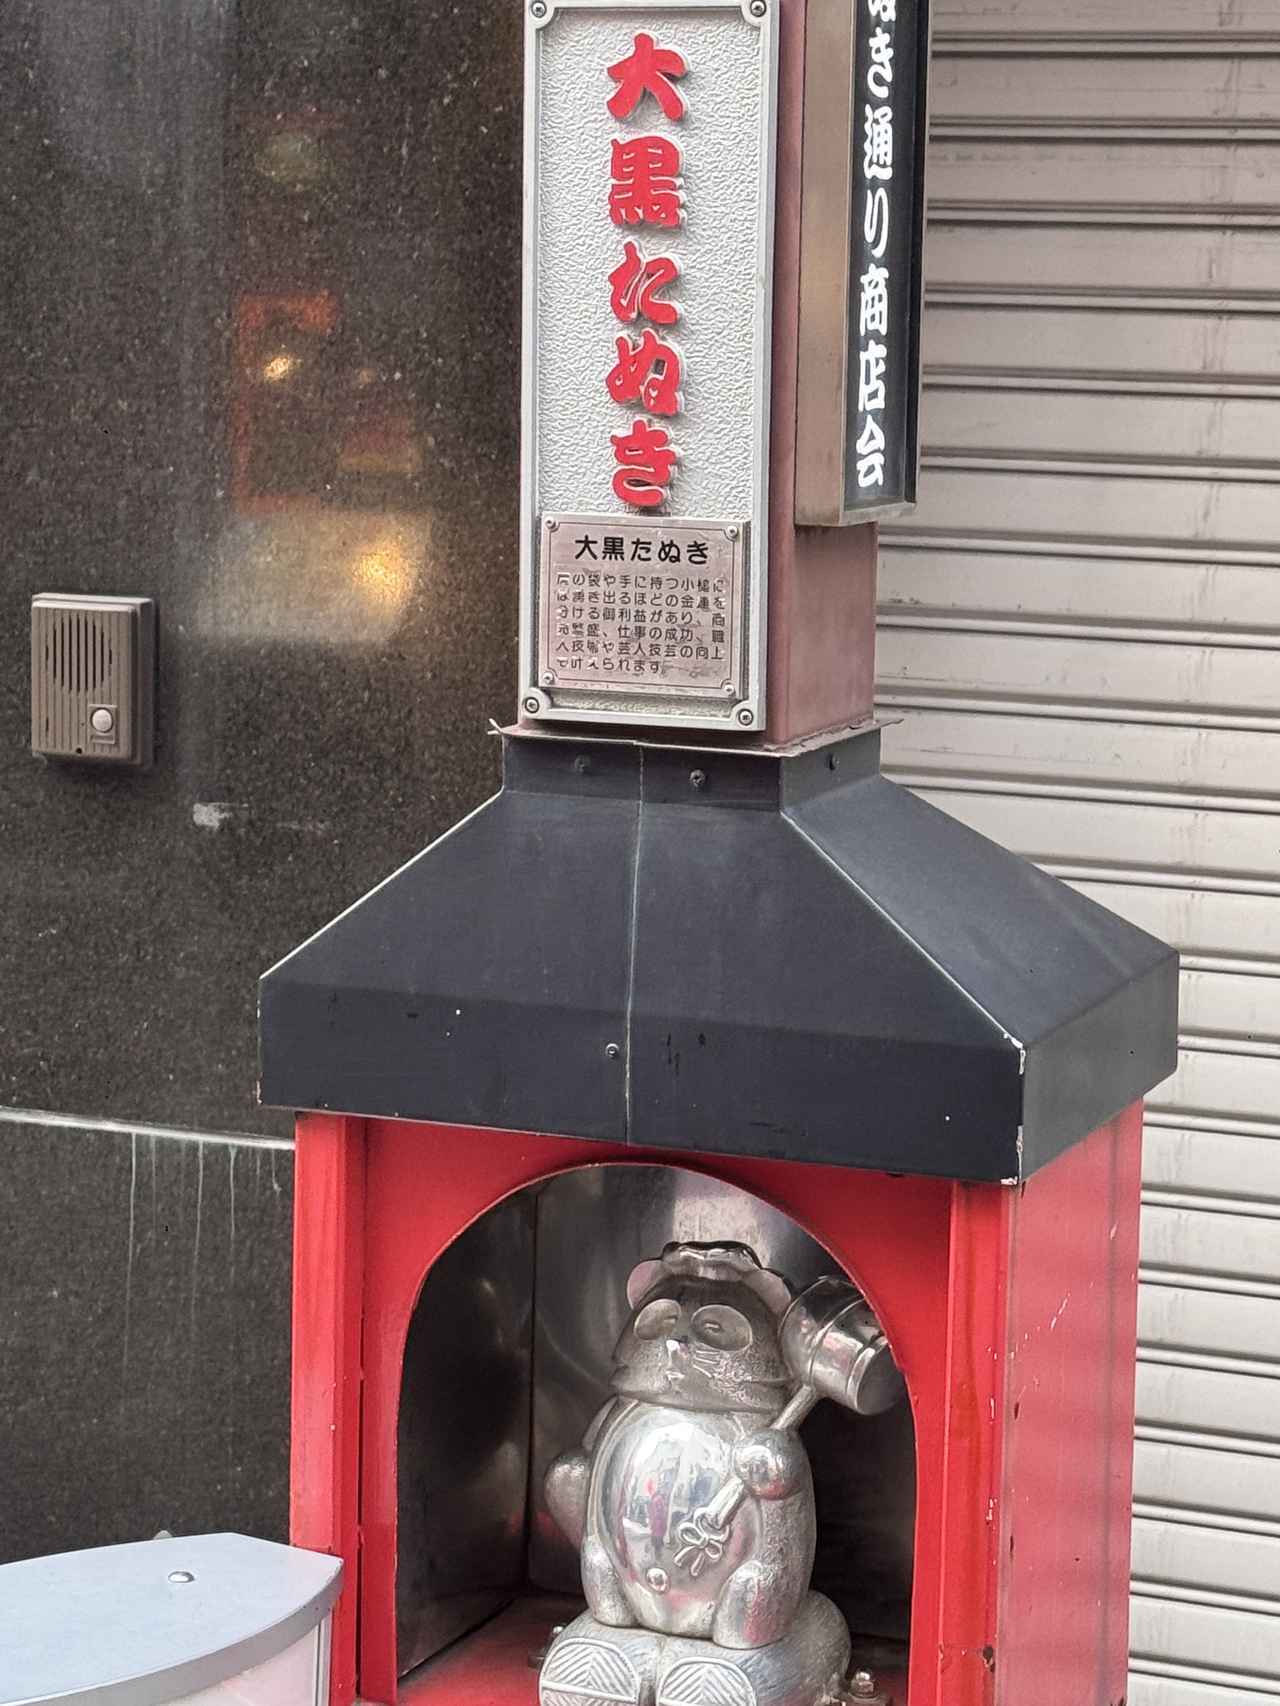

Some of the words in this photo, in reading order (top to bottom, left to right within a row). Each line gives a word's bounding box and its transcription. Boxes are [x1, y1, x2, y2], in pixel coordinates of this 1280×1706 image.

[606, 32, 686, 507] 大黒たぬき
[575, 535, 709, 564] 大黒たぬき
